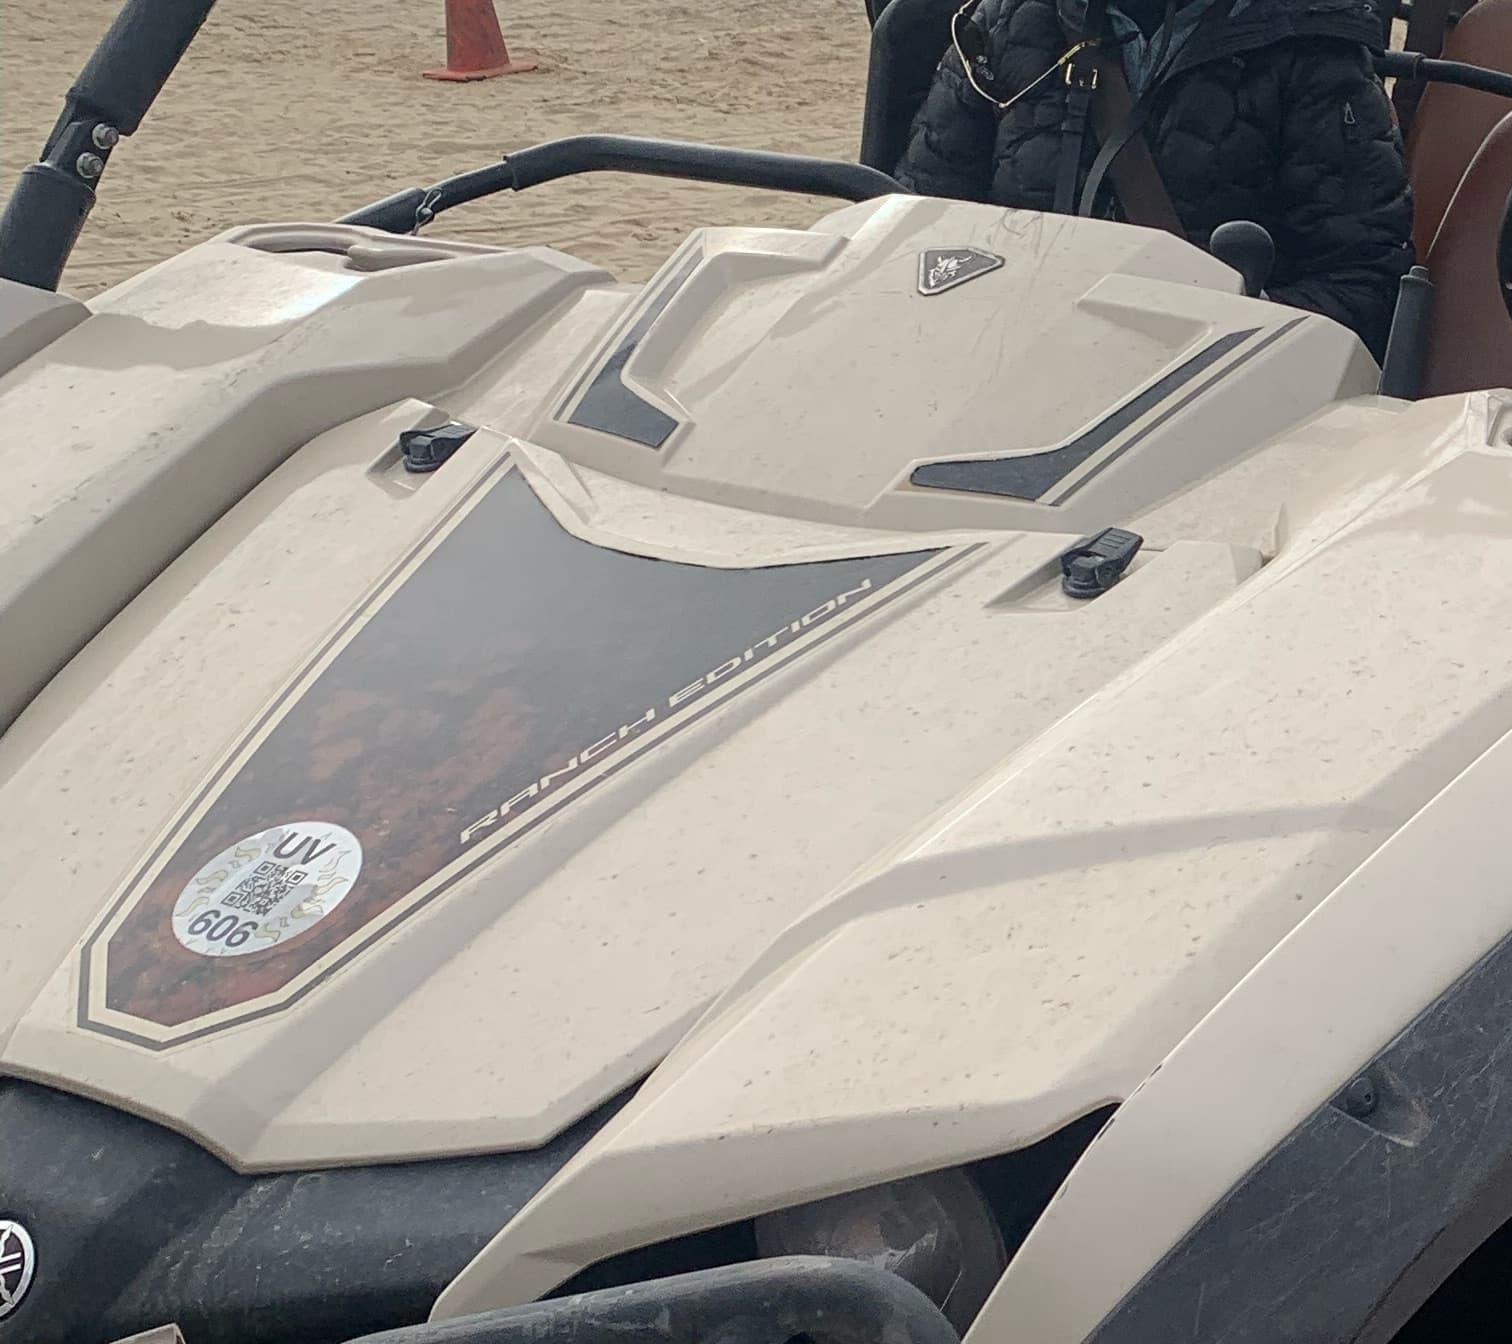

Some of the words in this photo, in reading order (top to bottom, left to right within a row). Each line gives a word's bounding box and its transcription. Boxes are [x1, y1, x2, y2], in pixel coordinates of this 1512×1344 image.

[460, 707, 655, 844] RANCH
[668, 578, 871, 707] EDITION
[273, 832, 337, 866] UV
[187, 909, 259, 947] 606
